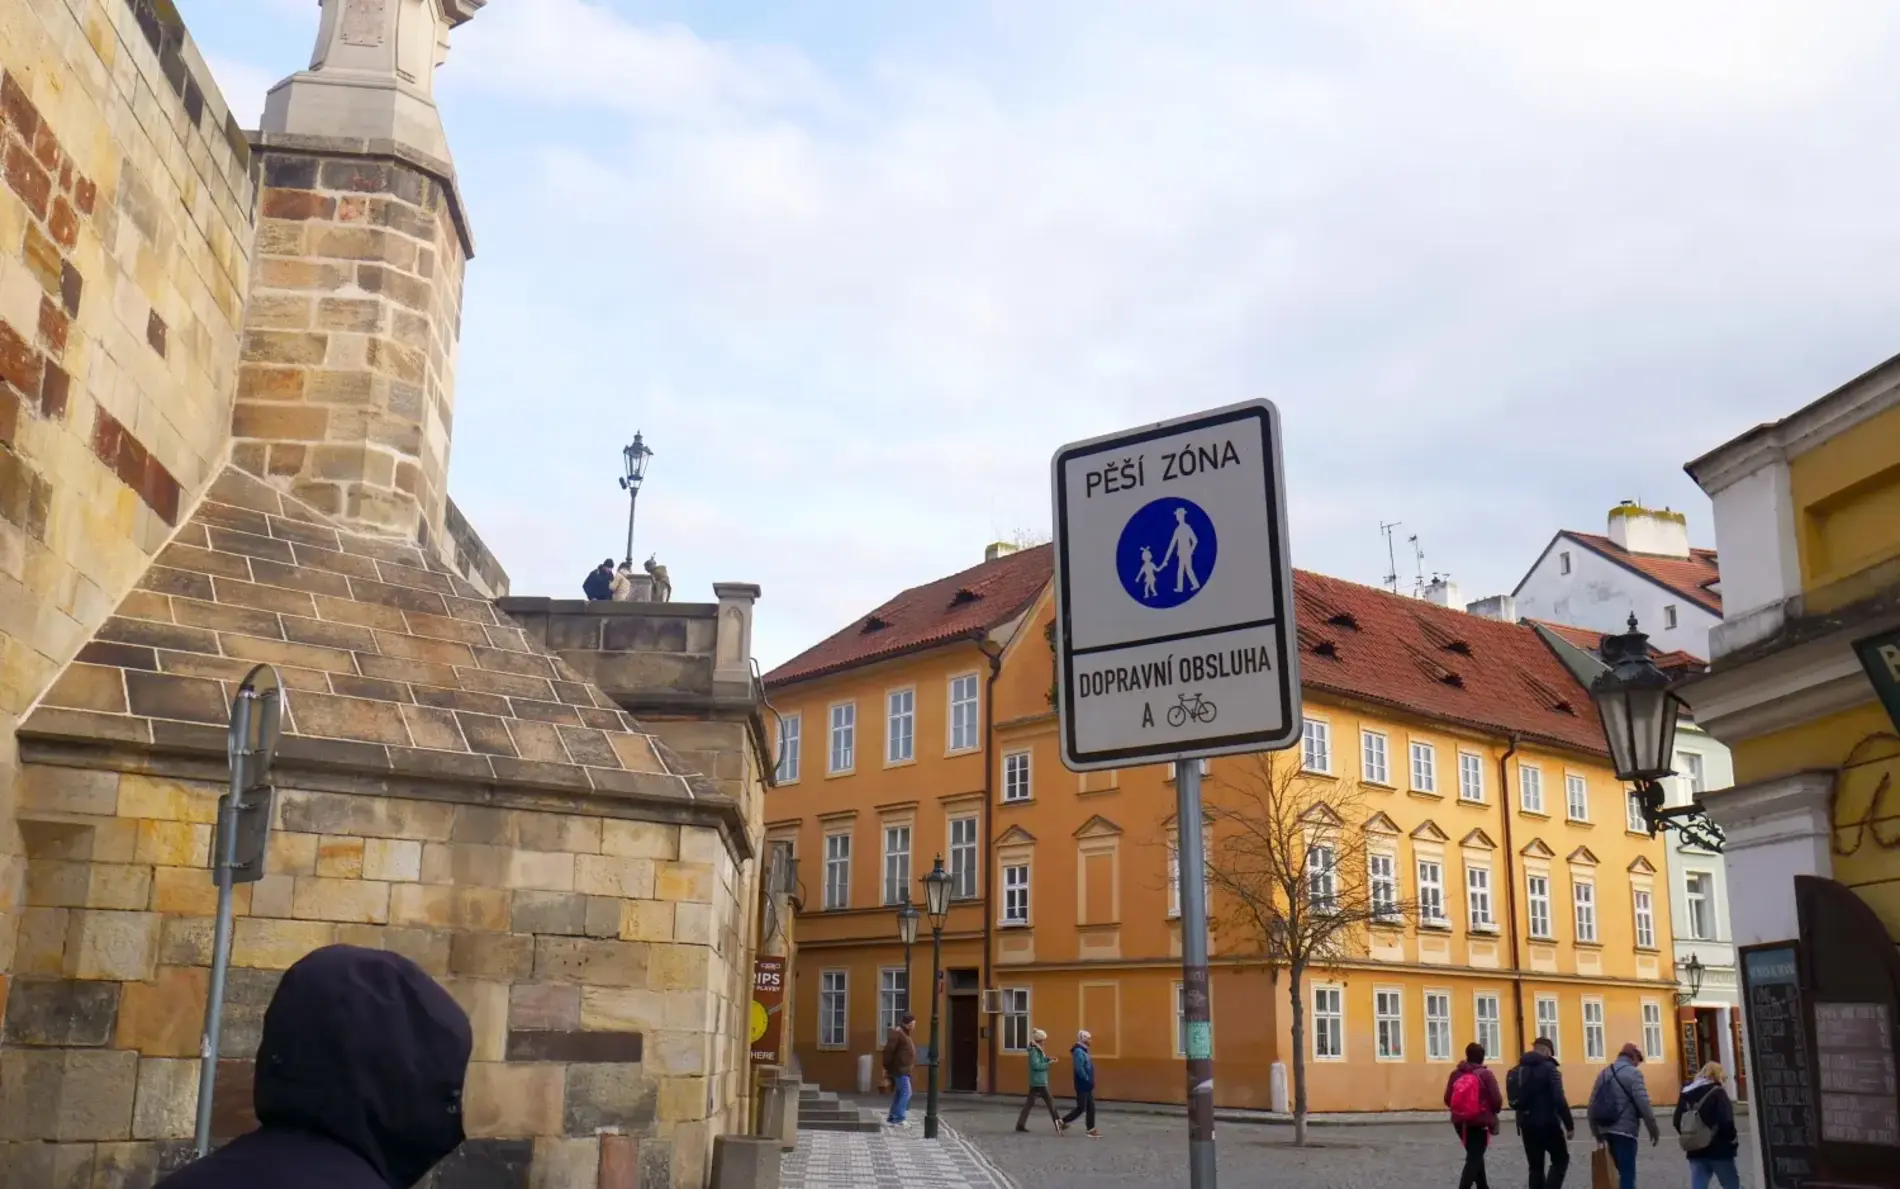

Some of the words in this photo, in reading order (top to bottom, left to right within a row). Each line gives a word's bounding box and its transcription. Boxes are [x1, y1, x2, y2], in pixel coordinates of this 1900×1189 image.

[1086, 456, 1145, 498] PĚŠÍ
[1161, 440, 1241, 482] ZÓNA
[1080, 655, 1173, 698] DOPRAVNÍ
[1179, 646, 1272, 684] OBSLUHA
[1142, 703, 1155, 728] A
